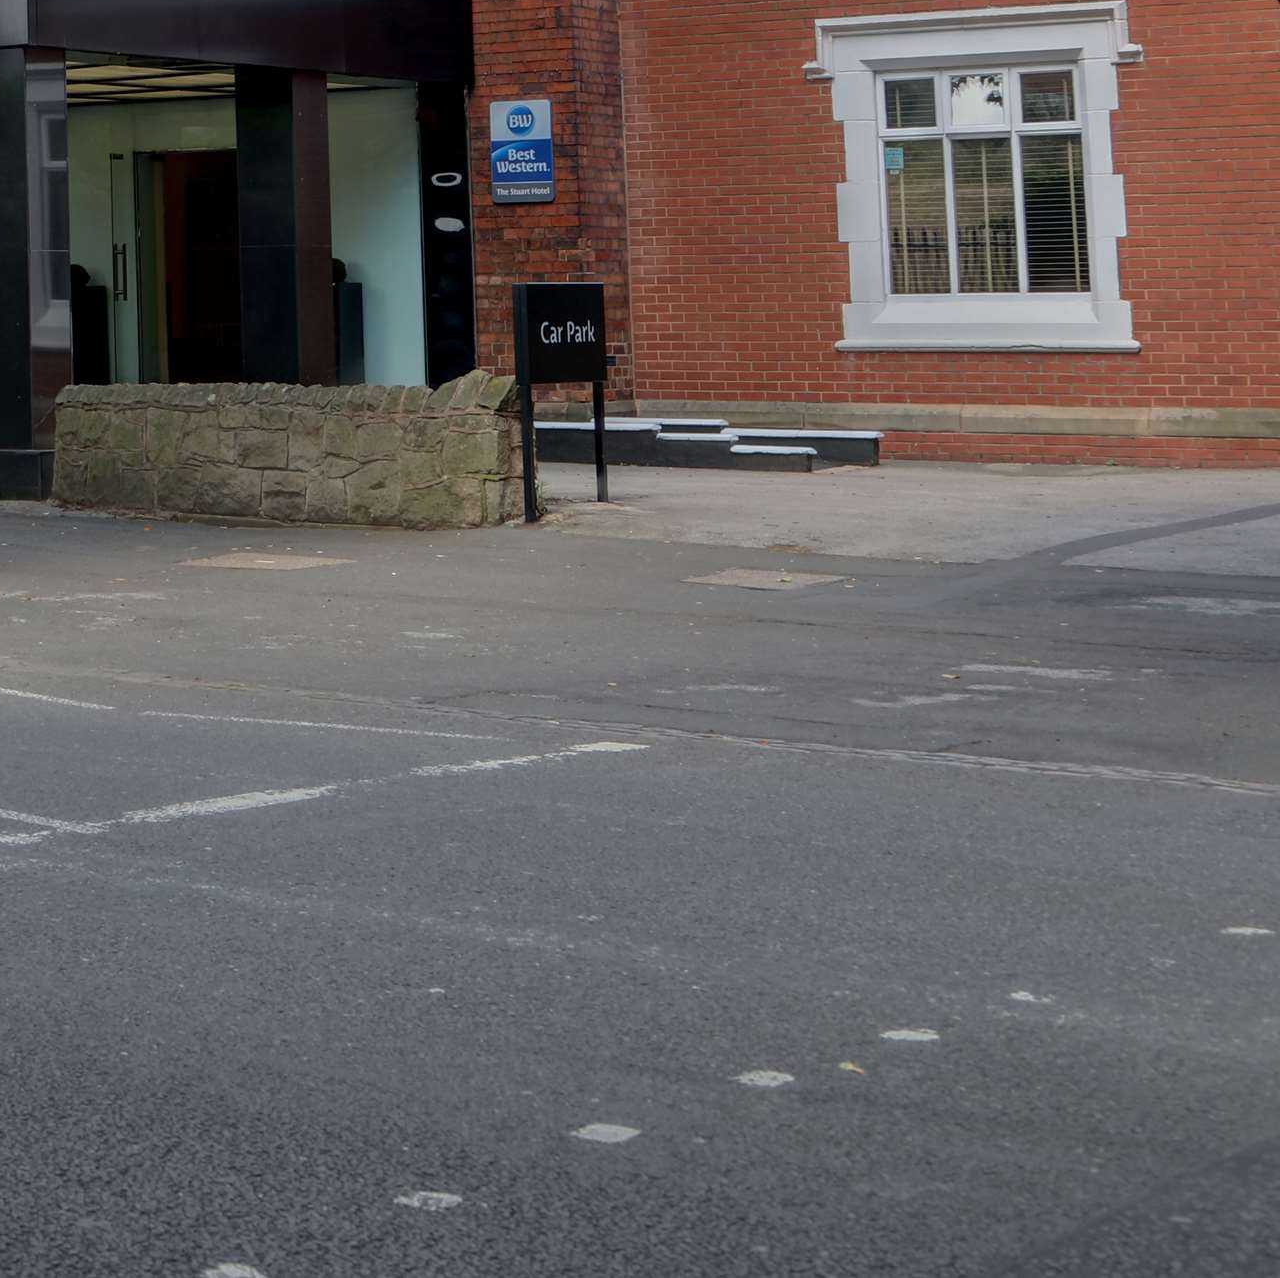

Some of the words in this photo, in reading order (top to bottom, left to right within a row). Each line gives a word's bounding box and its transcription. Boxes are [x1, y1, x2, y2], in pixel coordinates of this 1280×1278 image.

[509, 113, 532, 128] BW
[508, 148, 535, 161] Best
[497, 187, 509, 196] The
[510, 187, 530, 196] Stuart
[531, 186, 550, 195] Hotel
[540, 321, 563, 343] Car
[566, 319, 596, 343] Park
